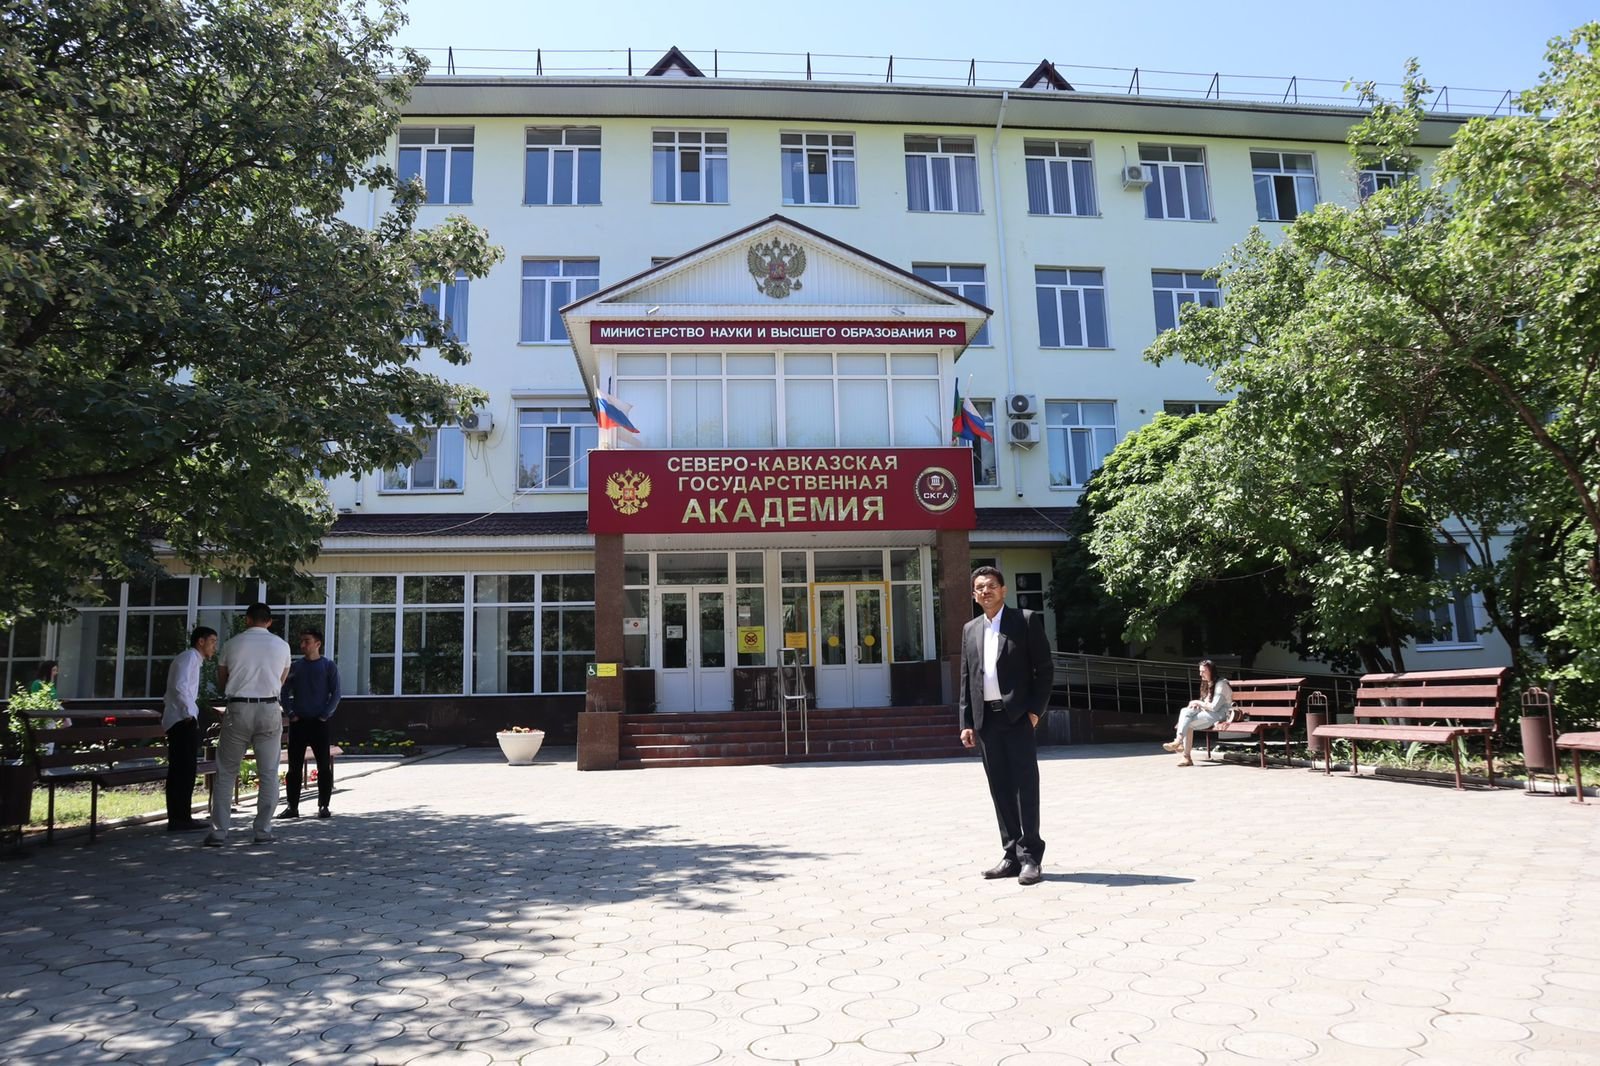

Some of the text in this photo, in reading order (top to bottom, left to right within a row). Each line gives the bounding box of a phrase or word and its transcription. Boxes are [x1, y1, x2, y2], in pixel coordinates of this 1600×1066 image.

[600, 327, 957, 339] МИНИСТЕРСТВО НАУКИ И ВЫСШЕГО ОБРАЗОВАНИЯ РФ
[667, 455, 898, 472] СЕВЕРО-КАВКАЗСКАЯ
[678, 475, 888, 494] ГОСУДАРСТВЕННАЯ
[681, 496, 884, 528] АКАДЕМИЯ
